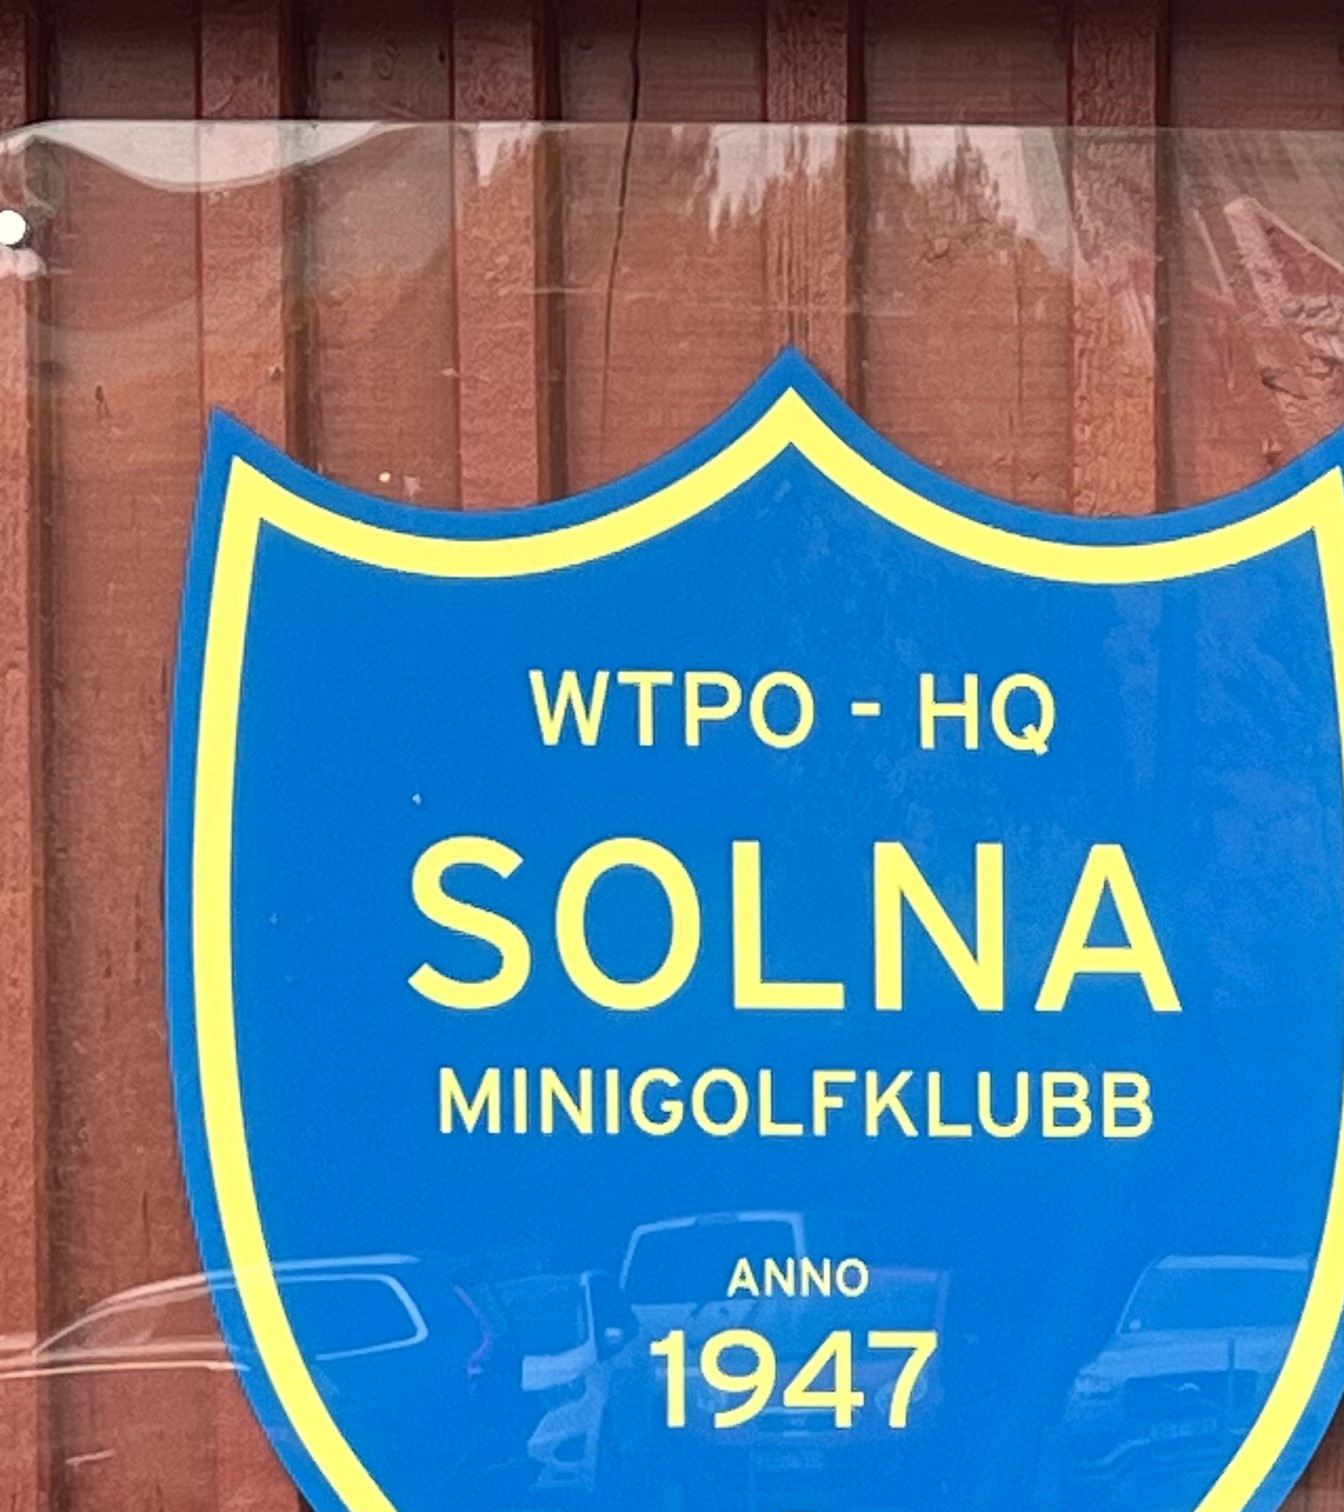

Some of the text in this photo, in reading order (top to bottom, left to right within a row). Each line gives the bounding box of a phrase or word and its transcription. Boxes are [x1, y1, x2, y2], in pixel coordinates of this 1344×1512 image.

[529, 669, 815, 750] WTPO
[919, 672, 1056, 756] HQ
[407, 834, 1183, 1013] SOLNA
[438, 1066, 1154, 1139] MINIGOLFKLUBB
[726, 1256, 870, 1298] ANNO
[649, 1328, 939, 1430] 1947
